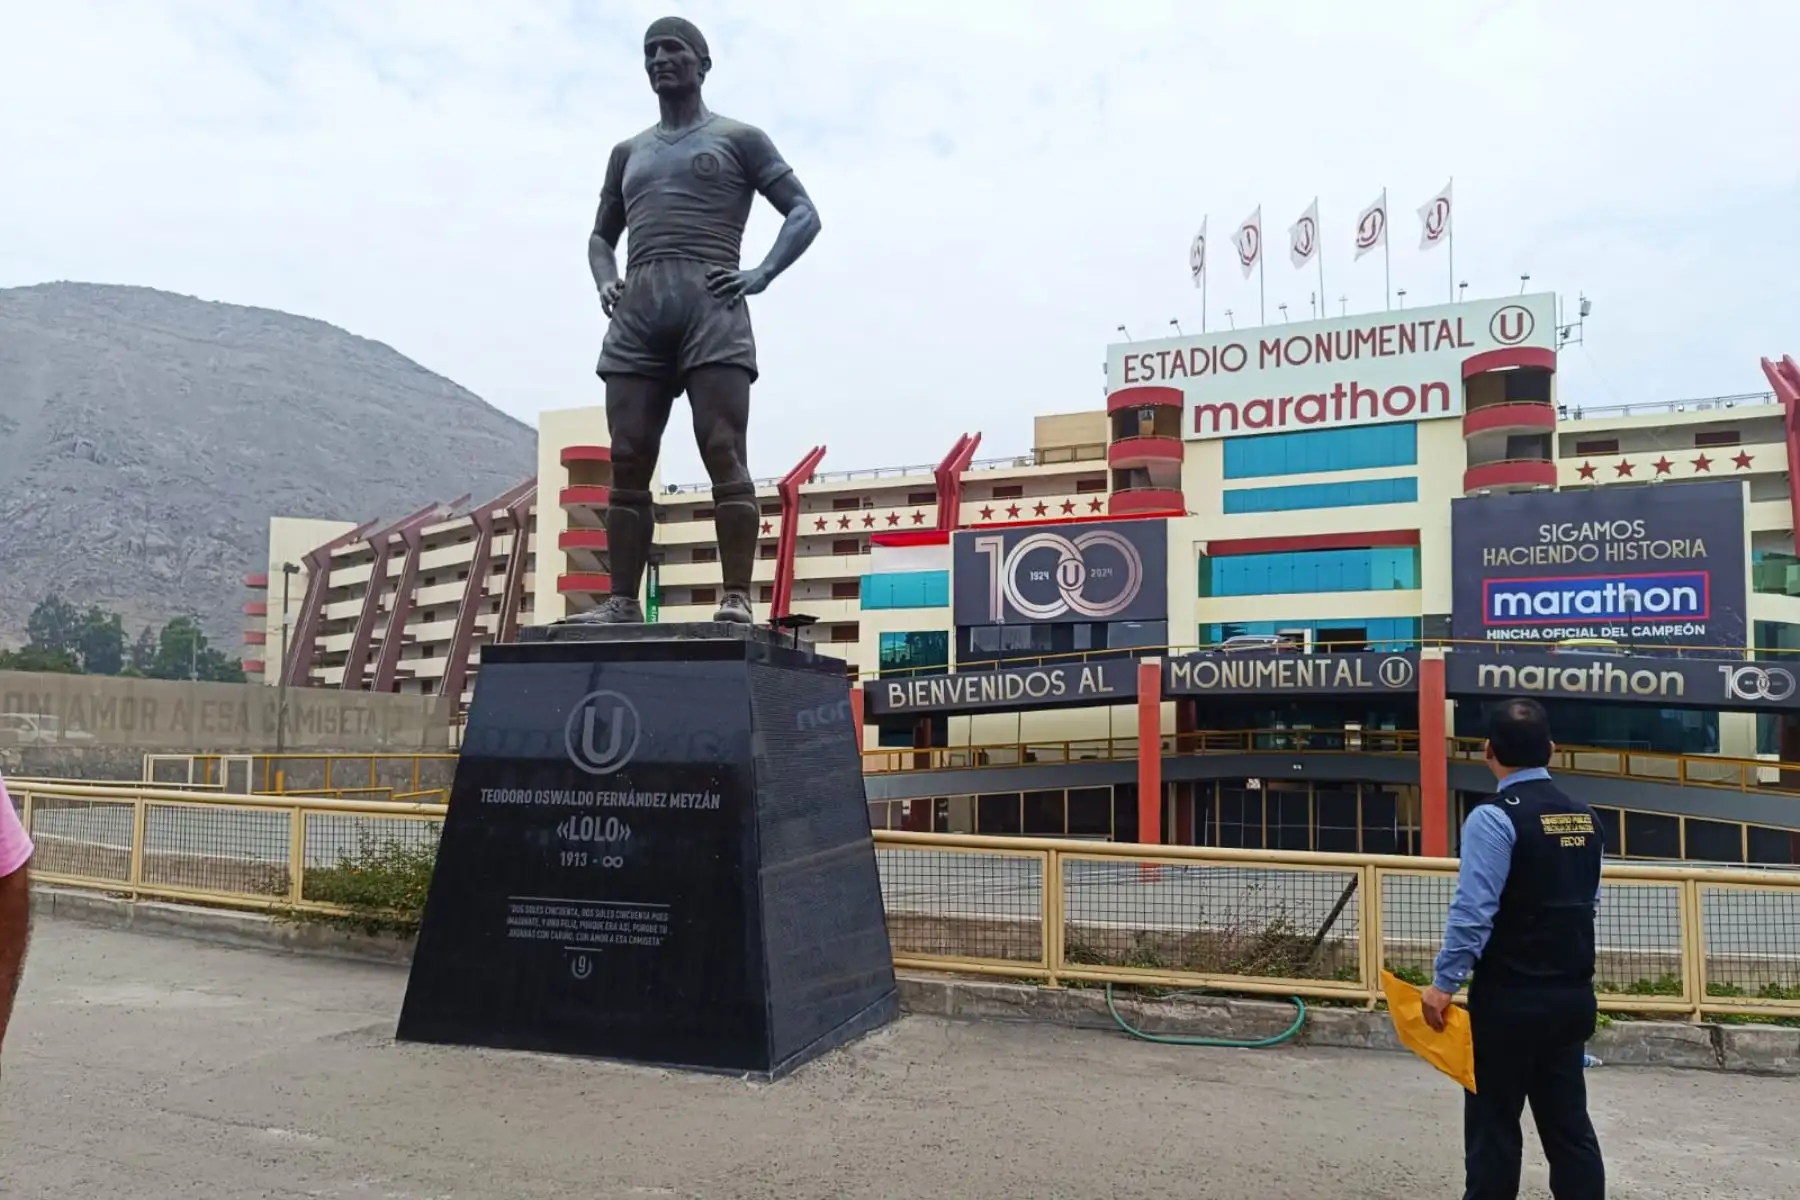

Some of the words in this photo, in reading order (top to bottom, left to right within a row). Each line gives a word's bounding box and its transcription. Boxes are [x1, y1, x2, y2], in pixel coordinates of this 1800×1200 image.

[1124, 342, 1248, 383] ESTADIO
[1259, 316, 1475, 369] MONUMENTAL
[1500, 313, 1524, 340] U
[1193, 380, 1450, 434] marathon
[1539, 519, 1645, 543] SIGAMOS
[1483, 543, 1599, 566] HACIENDO
[1605, 539, 1708, 561] HISTORIA
[975, 529, 1143, 624] 100
[1030, 571, 1049, 580] 1924
[1063, 564, 1079, 587] U
[1090, 568, 1113, 578] 2024
[1493, 583, 1697, 616] marathon
[1487, 628, 1540, 640] HINCHA
[1542, 626, 1597, 639] OFICIAL
[1601, 626, 1628, 638] DEL
[1631, 622, 1705, 637] CAMPEÓN
[888, 671, 1065, 709] BIENVENIDOS
[1078, 666, 1114, 693] AL
[1171, 658, 1373, 689] MONUMENTAL
[1386, 661, 1405, 684] U
[1477, 662, 1684, 696] marathon
[1719, 665, 1796, 701] 100
[67, 692, 157, 732] AMOR
[170, 697, 188, 732] A
[200, 699, 249, 734] ESA
[582, 706, 624, 764] U
[480, 788, 532, 804] TEODORO
[534, 790, 595, 806] OSWALDO
[596, 789, 667, 808] FERNÁNDEZ
[669, 790, 721, 809] MEYZÁN
[560, 852, 587, 867] 1913
